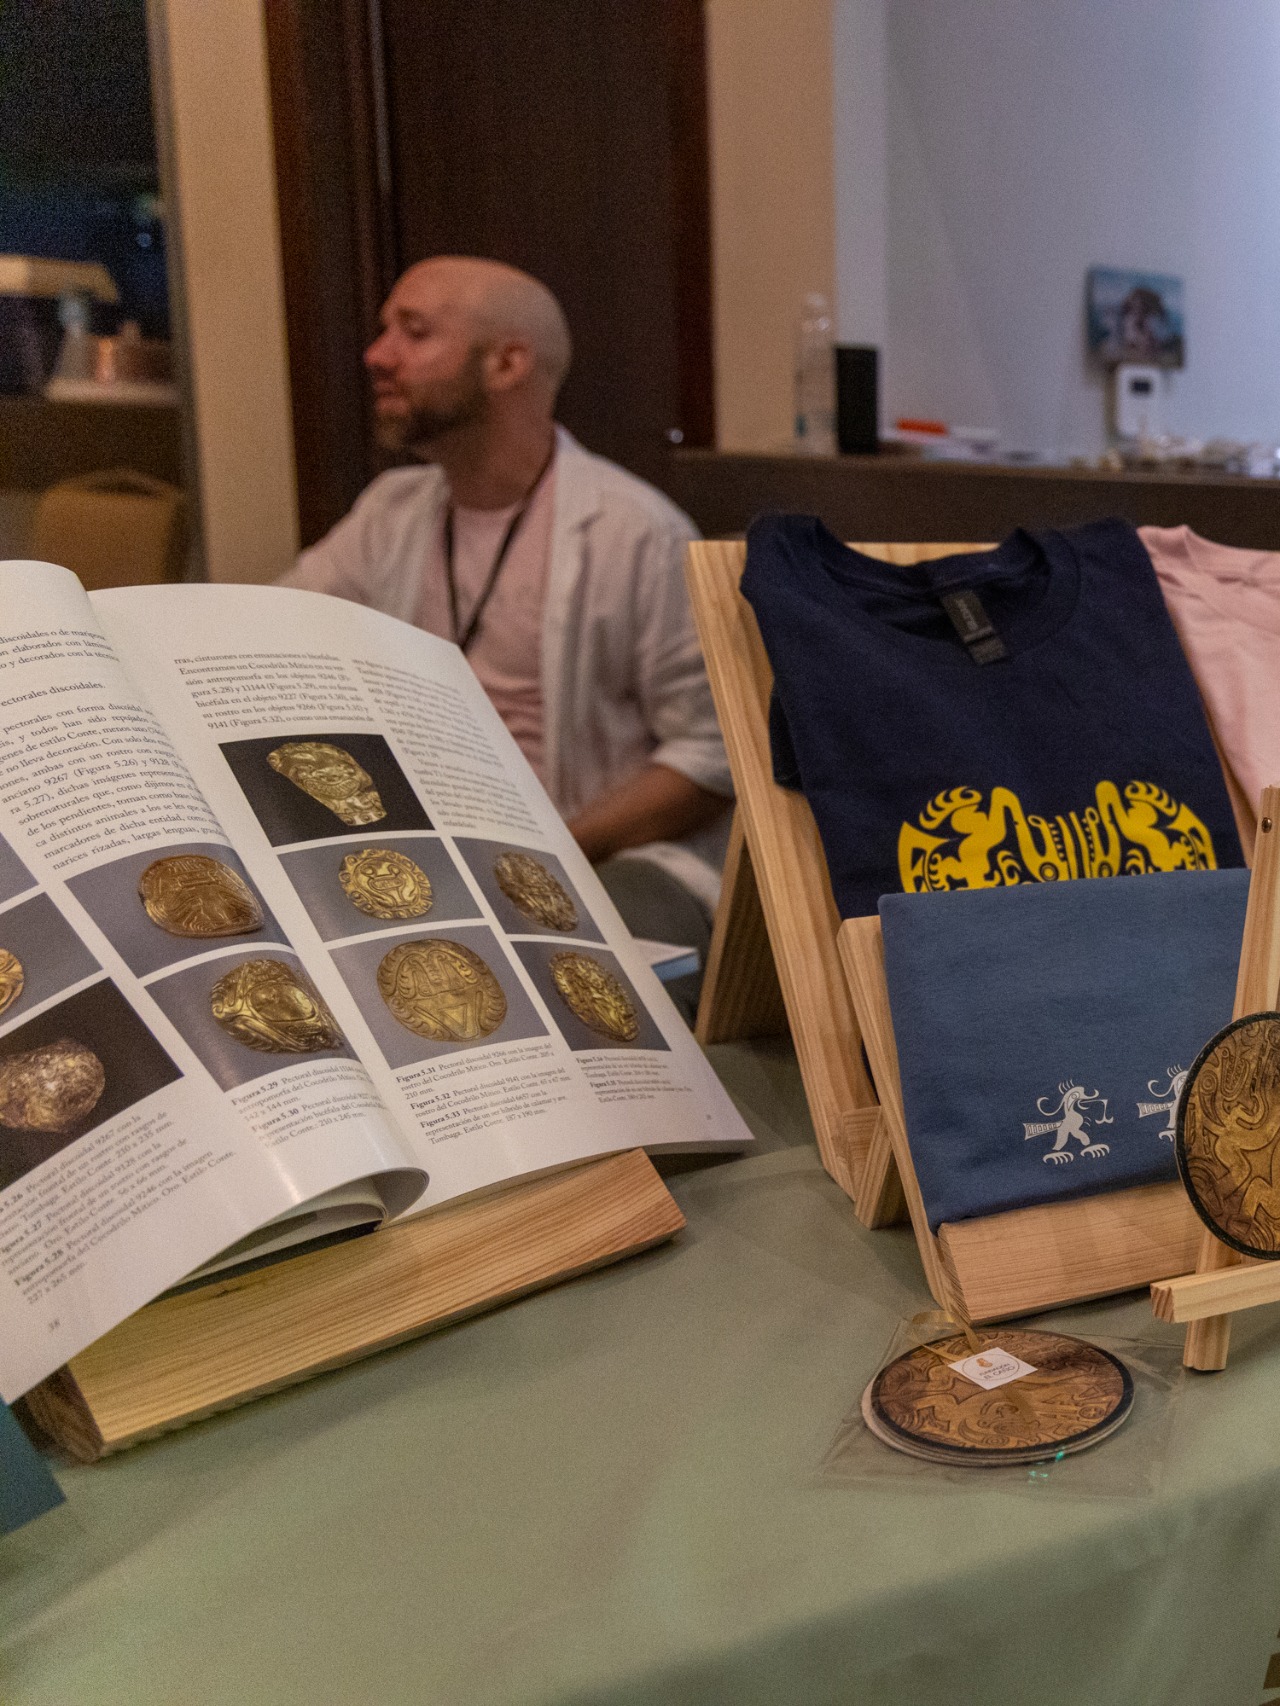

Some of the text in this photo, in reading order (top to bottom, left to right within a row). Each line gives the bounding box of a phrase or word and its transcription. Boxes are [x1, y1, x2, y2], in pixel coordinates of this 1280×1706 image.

[3, 713, 53, 735] pectorales
[31, 725, 58, 737] todos
[62, 719, 83, 729] han
[88, 714, 107, 724] sido
[40, 735, 67, 748] estilo
[102, 735, 123, 746] Con
[32, 761, 64, 777] ambas
[44, 772, 69, 786] 9267
[58, 780, 89, 796] dichas
[18, 794, 90, 826] sobrenaturales
[49, 820, 90, 843] distintos
[96, 808, 138, 826] animales
[44, 831, 101, 859] marcadores
[119, 818, 146, 833] dicha
[53, 851, 88, 871] narices
